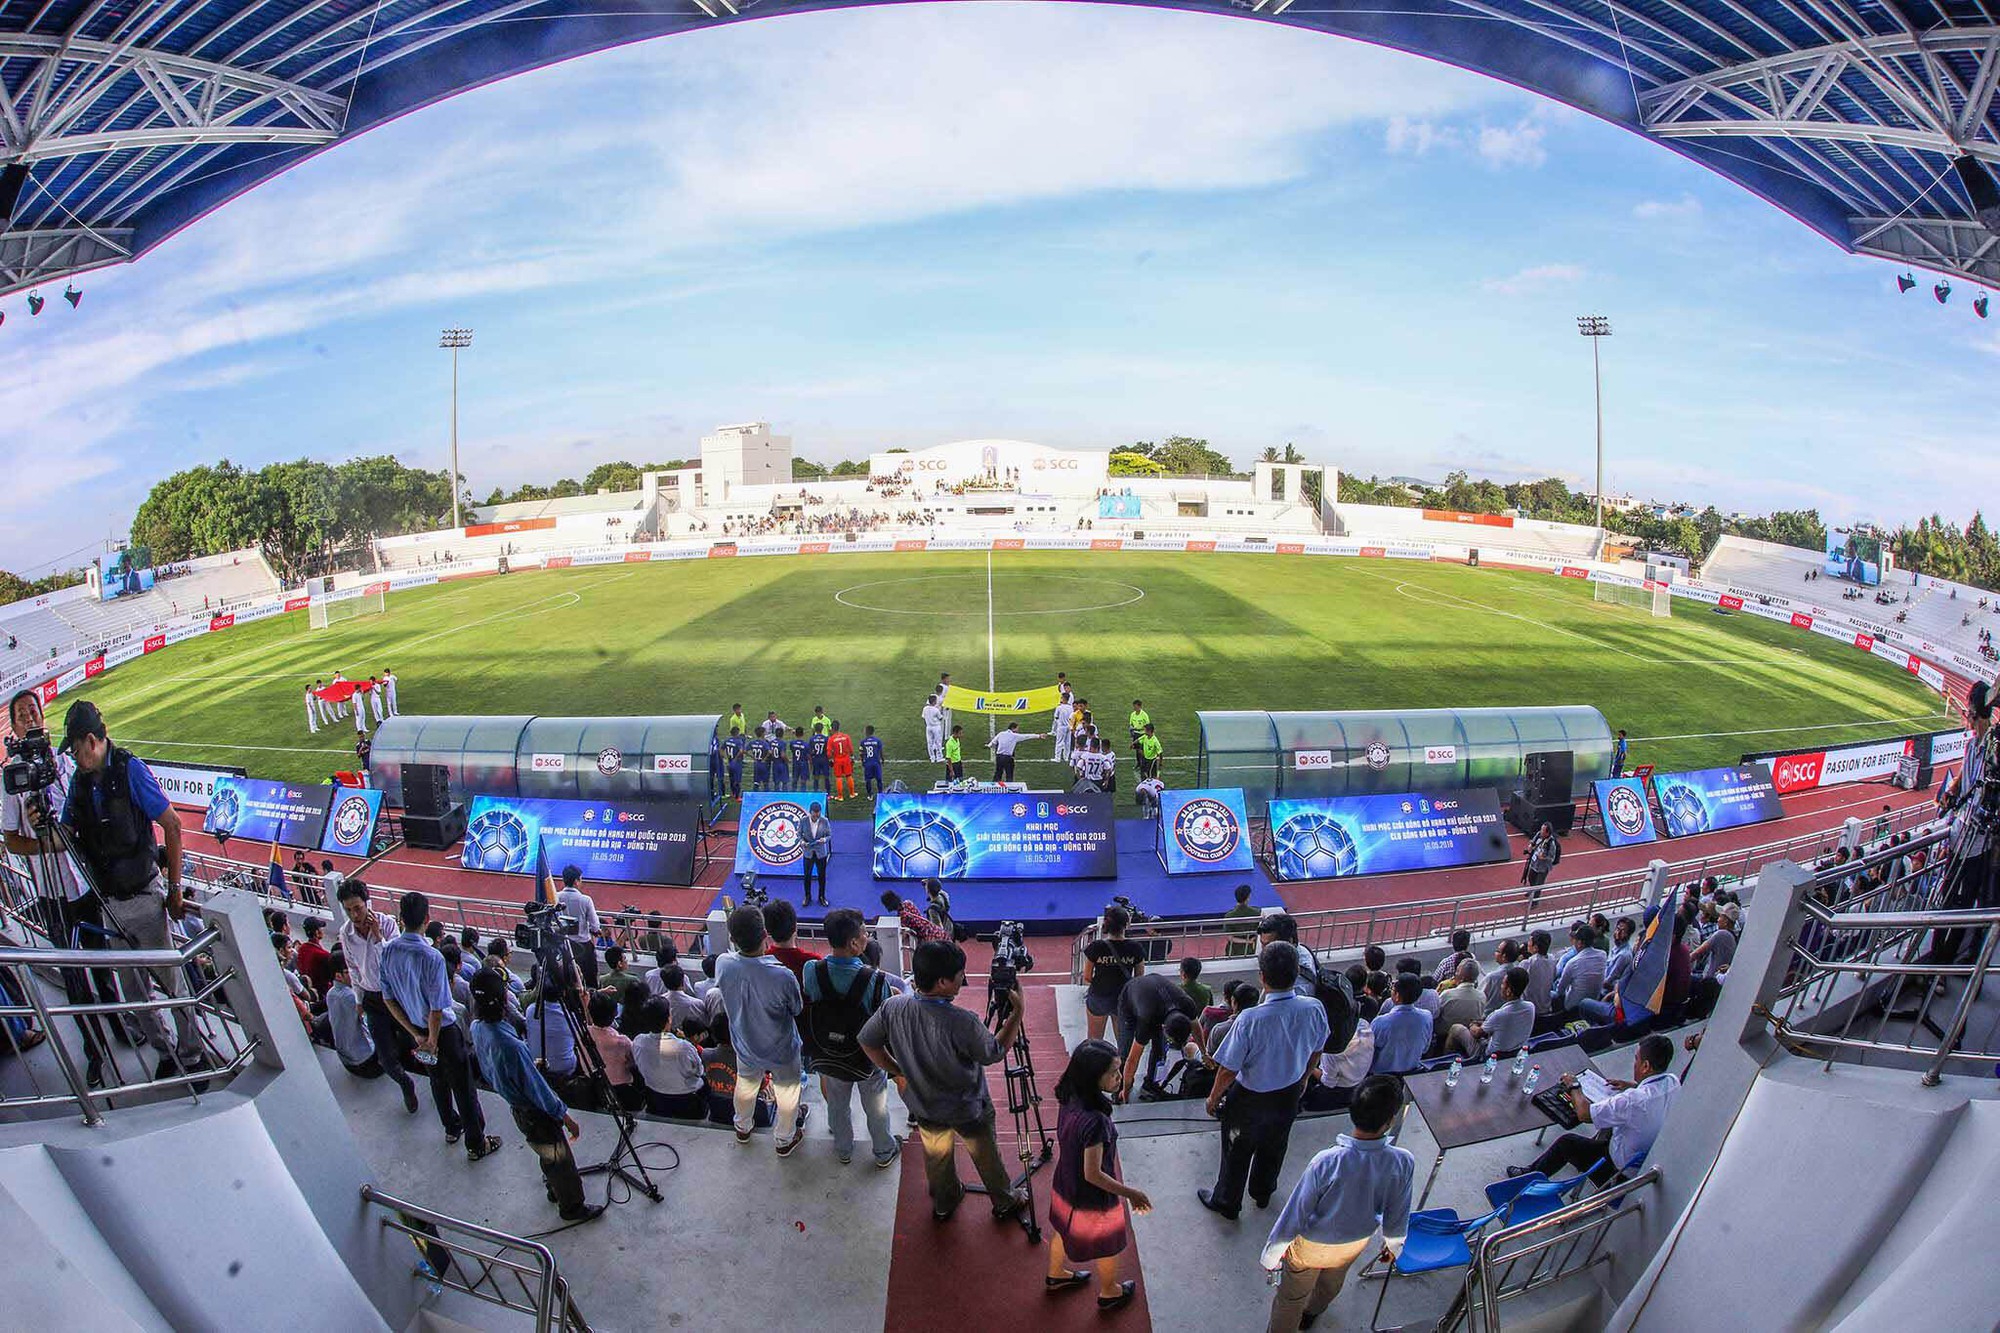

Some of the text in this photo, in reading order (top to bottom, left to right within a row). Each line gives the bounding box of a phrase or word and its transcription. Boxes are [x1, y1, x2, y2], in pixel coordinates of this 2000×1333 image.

[919, 460, 947, 471] SCG
[1050, 459, 1078, 470] SCG
[1572, 569, 1585, 577] SCG
[1729, 587, 1754, 598] PASSION
[1769, 596, 1789, 606] BETTER
[230, 602, 252, 611] BETTER
[1850, 618, 1904, 640] PASSION FOR BETTER
[78, 633, 132, 656] PASSION FOR BETTER
[1954, 655, 1997, 681] PASSION FOR BETTER
[814, 743, 825, 755] 97
[839, 742, 843, 754] 1
[865, 746, 874, 758] 18
[753, 749, 763, 760] 22
[795, 749, 801, 761] 9
[1310, 756, 1329, 764] SCG
[1437, 750, 1453, 759] SCG
[544, 759, 562, 767] SCG
[668, 759, 688, 768] SCG
[1826, 751, 1901, 774] PASSION FOR BETTER
[1088, 762, 1101, 775] 27
[1793, 762, 1816, 782] SCG
[183, 781, 203, 795] FOR
[1068, 806, 1088, 814] SCG
[1443, 801, 1458, 809] SCG
[628, 813, 645, 821] SCG
[1483, 814, 1497, 822] 2018
[1025, 823, 1042, 831] KHAI
[656, 832, 668, 841] GIA
[669, 833, 687, 842] 2018
[1042, 831, 1054, 840] NHÌ
[1056, 830, 1074, 842] QUỐC
[1088, 832, 1107, 840] 2018
[755, 845, 793, 862] FOOTBALL CLUB
[1184, 844, 1223, 859] FOOTBALL CLUB
